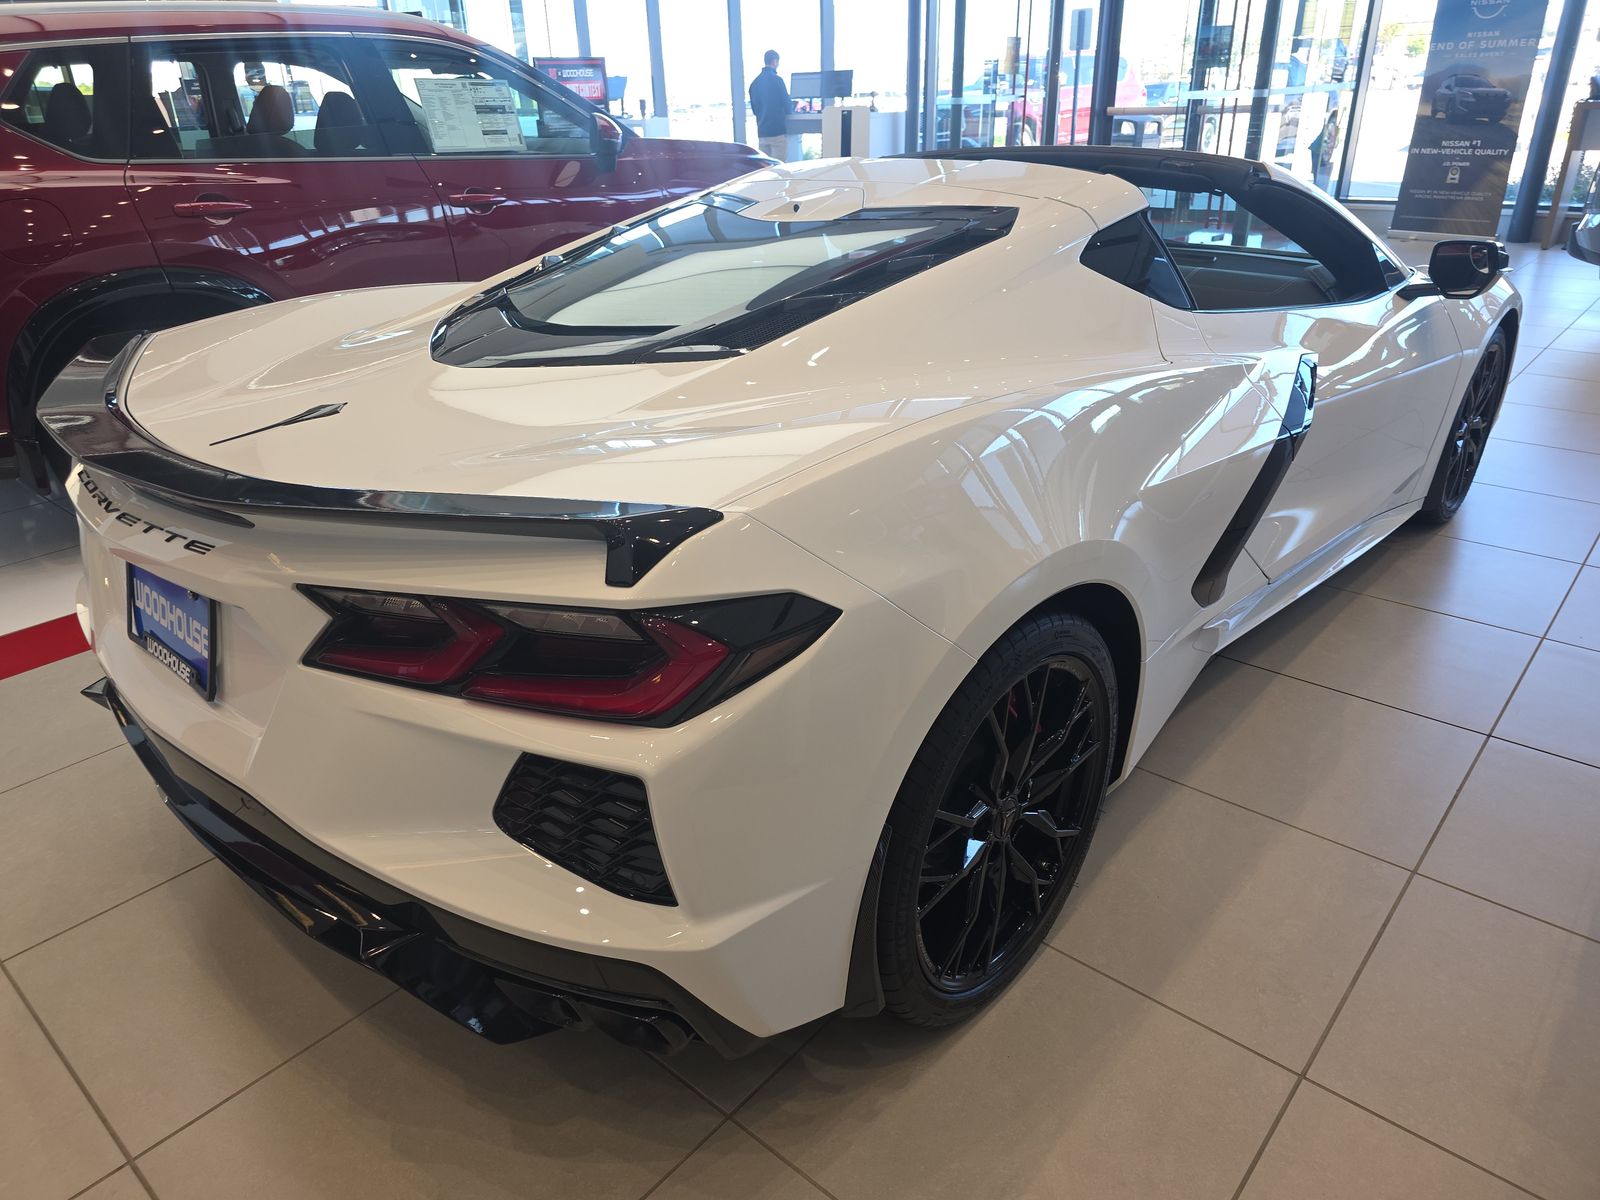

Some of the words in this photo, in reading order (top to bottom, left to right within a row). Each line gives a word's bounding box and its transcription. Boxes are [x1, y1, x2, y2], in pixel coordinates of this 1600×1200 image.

[1430, 41, 1454, 51] END
[1458, 41, 1475, 50] OF
[1479, 38, 1537, 49] SUMMER
[562, 69, 595, 78] WOODHOUSE
[77, 469, 216, 555] CORVETTE
[133, 577, 209, 659] WOODHOUSE
[146, 636, 191, 684] WOODHOUSE
